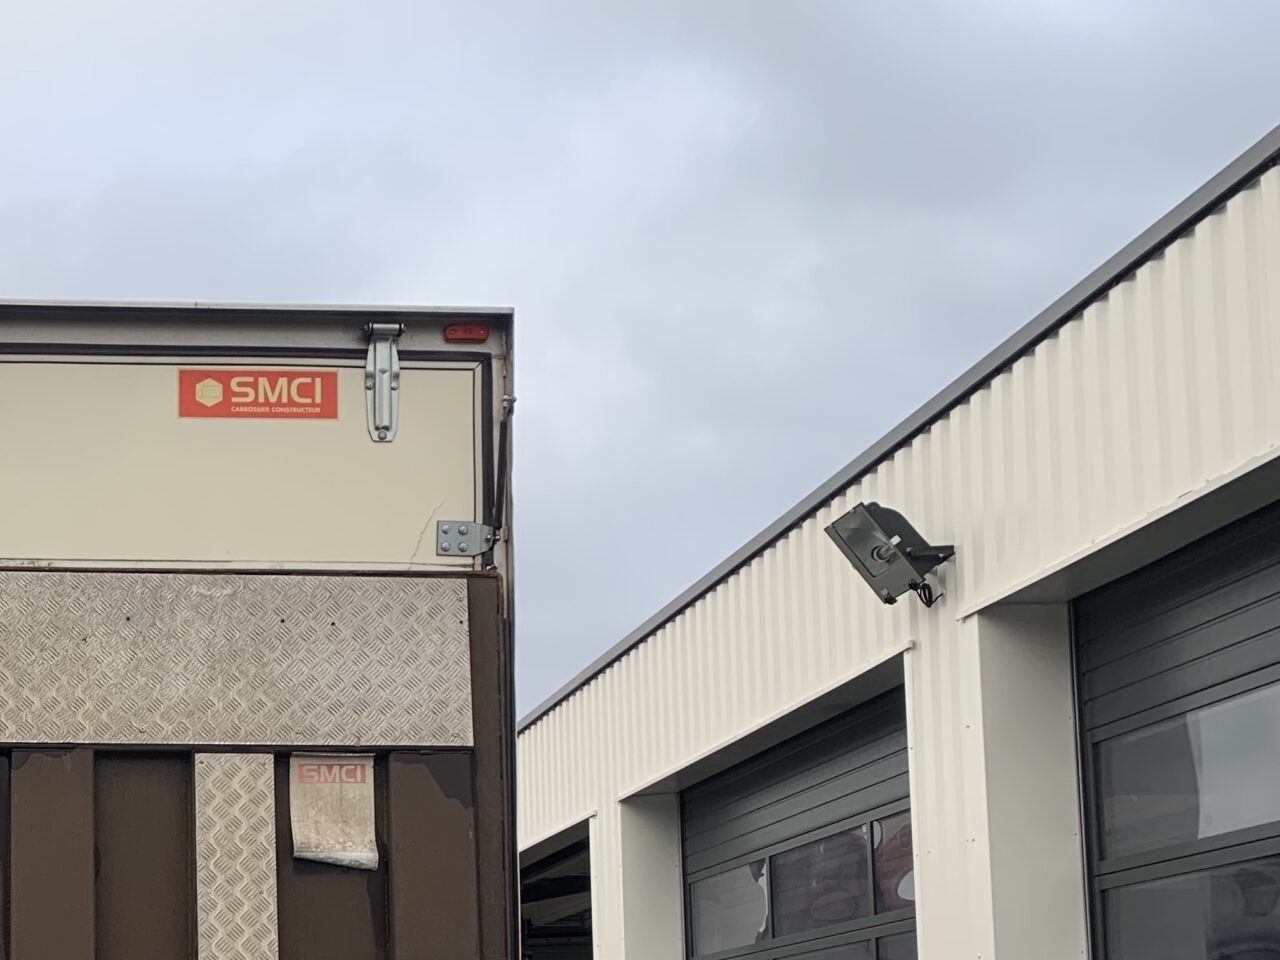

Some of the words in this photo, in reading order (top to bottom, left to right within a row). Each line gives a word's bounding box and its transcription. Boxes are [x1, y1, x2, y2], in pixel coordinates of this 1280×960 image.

[230, 376, 321, 404] SMCI
[271, 406, 321, 414] CONSTRUCTEUR
[302, 765, 361, 783] SMCI
